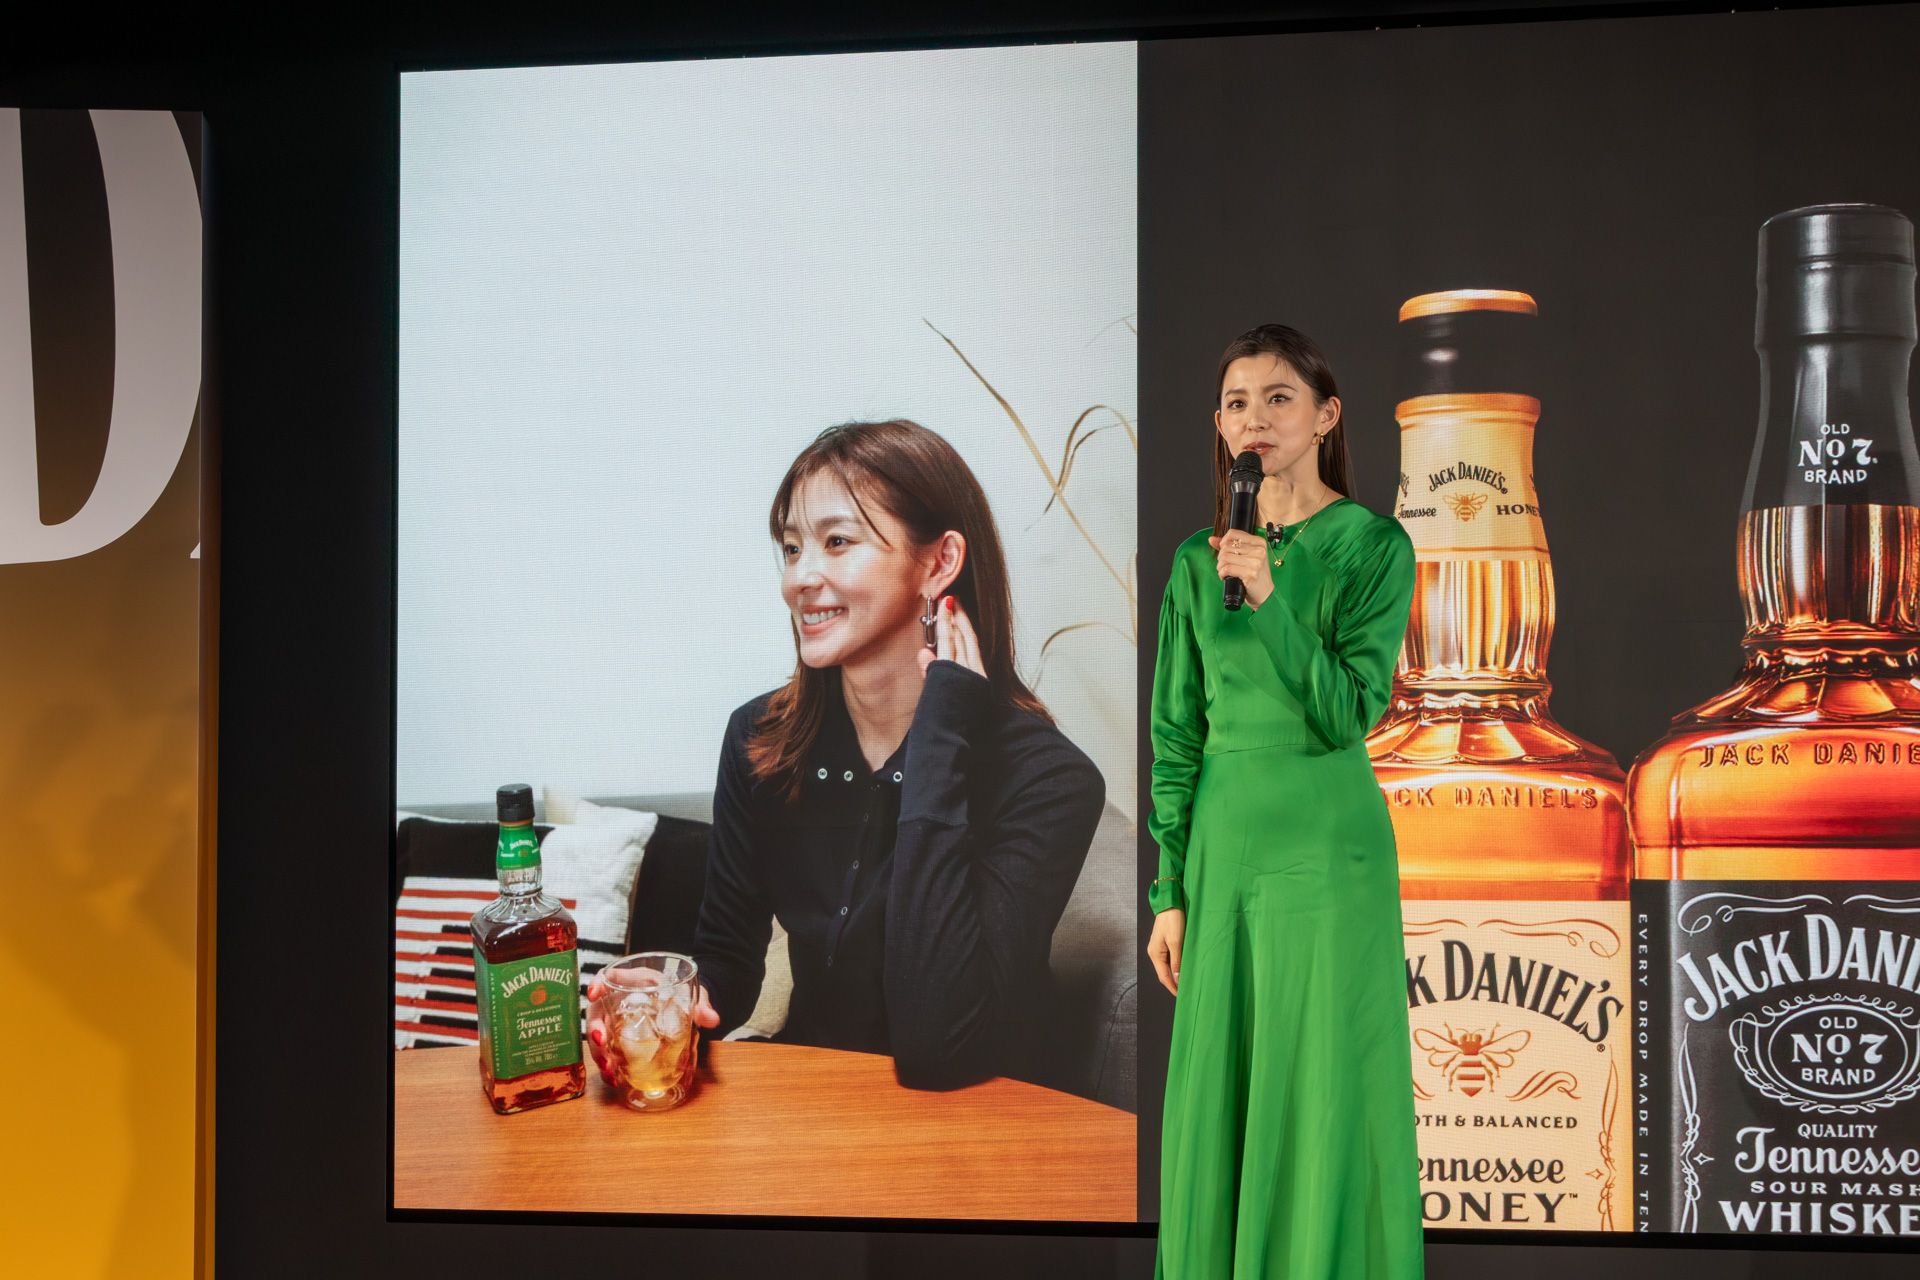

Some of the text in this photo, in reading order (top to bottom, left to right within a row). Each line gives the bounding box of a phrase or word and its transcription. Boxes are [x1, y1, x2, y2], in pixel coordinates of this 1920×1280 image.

[1820, 424, 1850, 435] OLD
[1428, 466, 1457, 492] JACK
[1804, 469, 1868, 484] BRAND
[1398, 503, 1437, 519] Tennessee
[1700, 743, 1790, 767] JACK
[1380, 786, 1598, 809] CK DANIEL'S
[1639, 914, 1648, 986] EVERY
[1676, 913, 1920, 1021] JACK DANI
[501, 966, 573, 999] JACK DANIEL'S
[1441, 940, 1624, 1043] DANIEL'S
[516, 1014, 562, 1031] Tennessee
[518, 1022, 563, 1040] APPLE
[1639, 1001, 1648, 1060] DROP
[1819, 1017, 1858, 1029] OLD
[1859, 1033, 1888, 1064] 7
[1801, 1068, 1876, 1085] BRAND
[1639, 1073, 1648, 1137] MADE
[1454, 1115, 1466, 1127] &
[1473, 1115, 1578, 1129] BALANCED
[1797, 1124, 1878, 1140] QUALITY
[1639, 1153, 1648, 1176] IN
[1751, 1180, 1827, 1195] SOUR
[1421, 1191, 1566, 1224] ONEY
